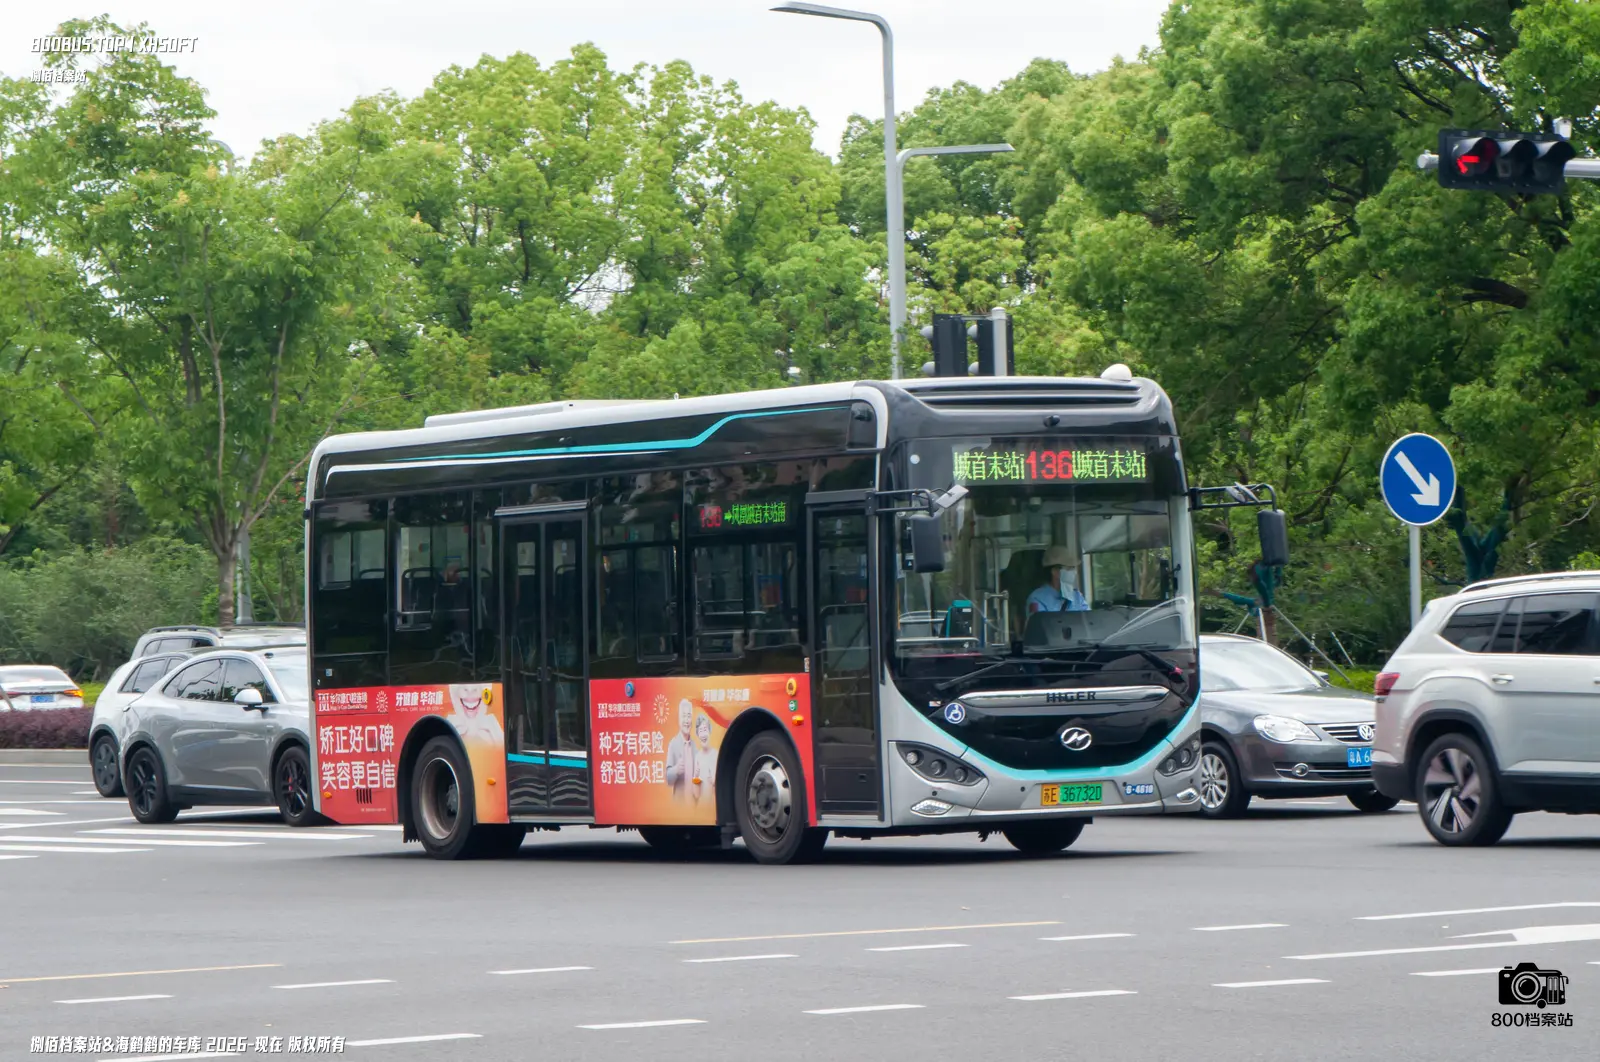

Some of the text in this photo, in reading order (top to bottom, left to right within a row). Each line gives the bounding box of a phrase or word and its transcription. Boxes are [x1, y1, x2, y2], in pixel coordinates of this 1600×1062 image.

[1025, 451, 1072, 480] 136
[700, 505, 722, 528] 136
[1046, 691, 1096, 703] HIGER
[320, 724, 395, 755] 矫正好口碑
[599, 731, 665, 756] 种牙有保险
[322, 759, 396, 790] 笑容更自信
